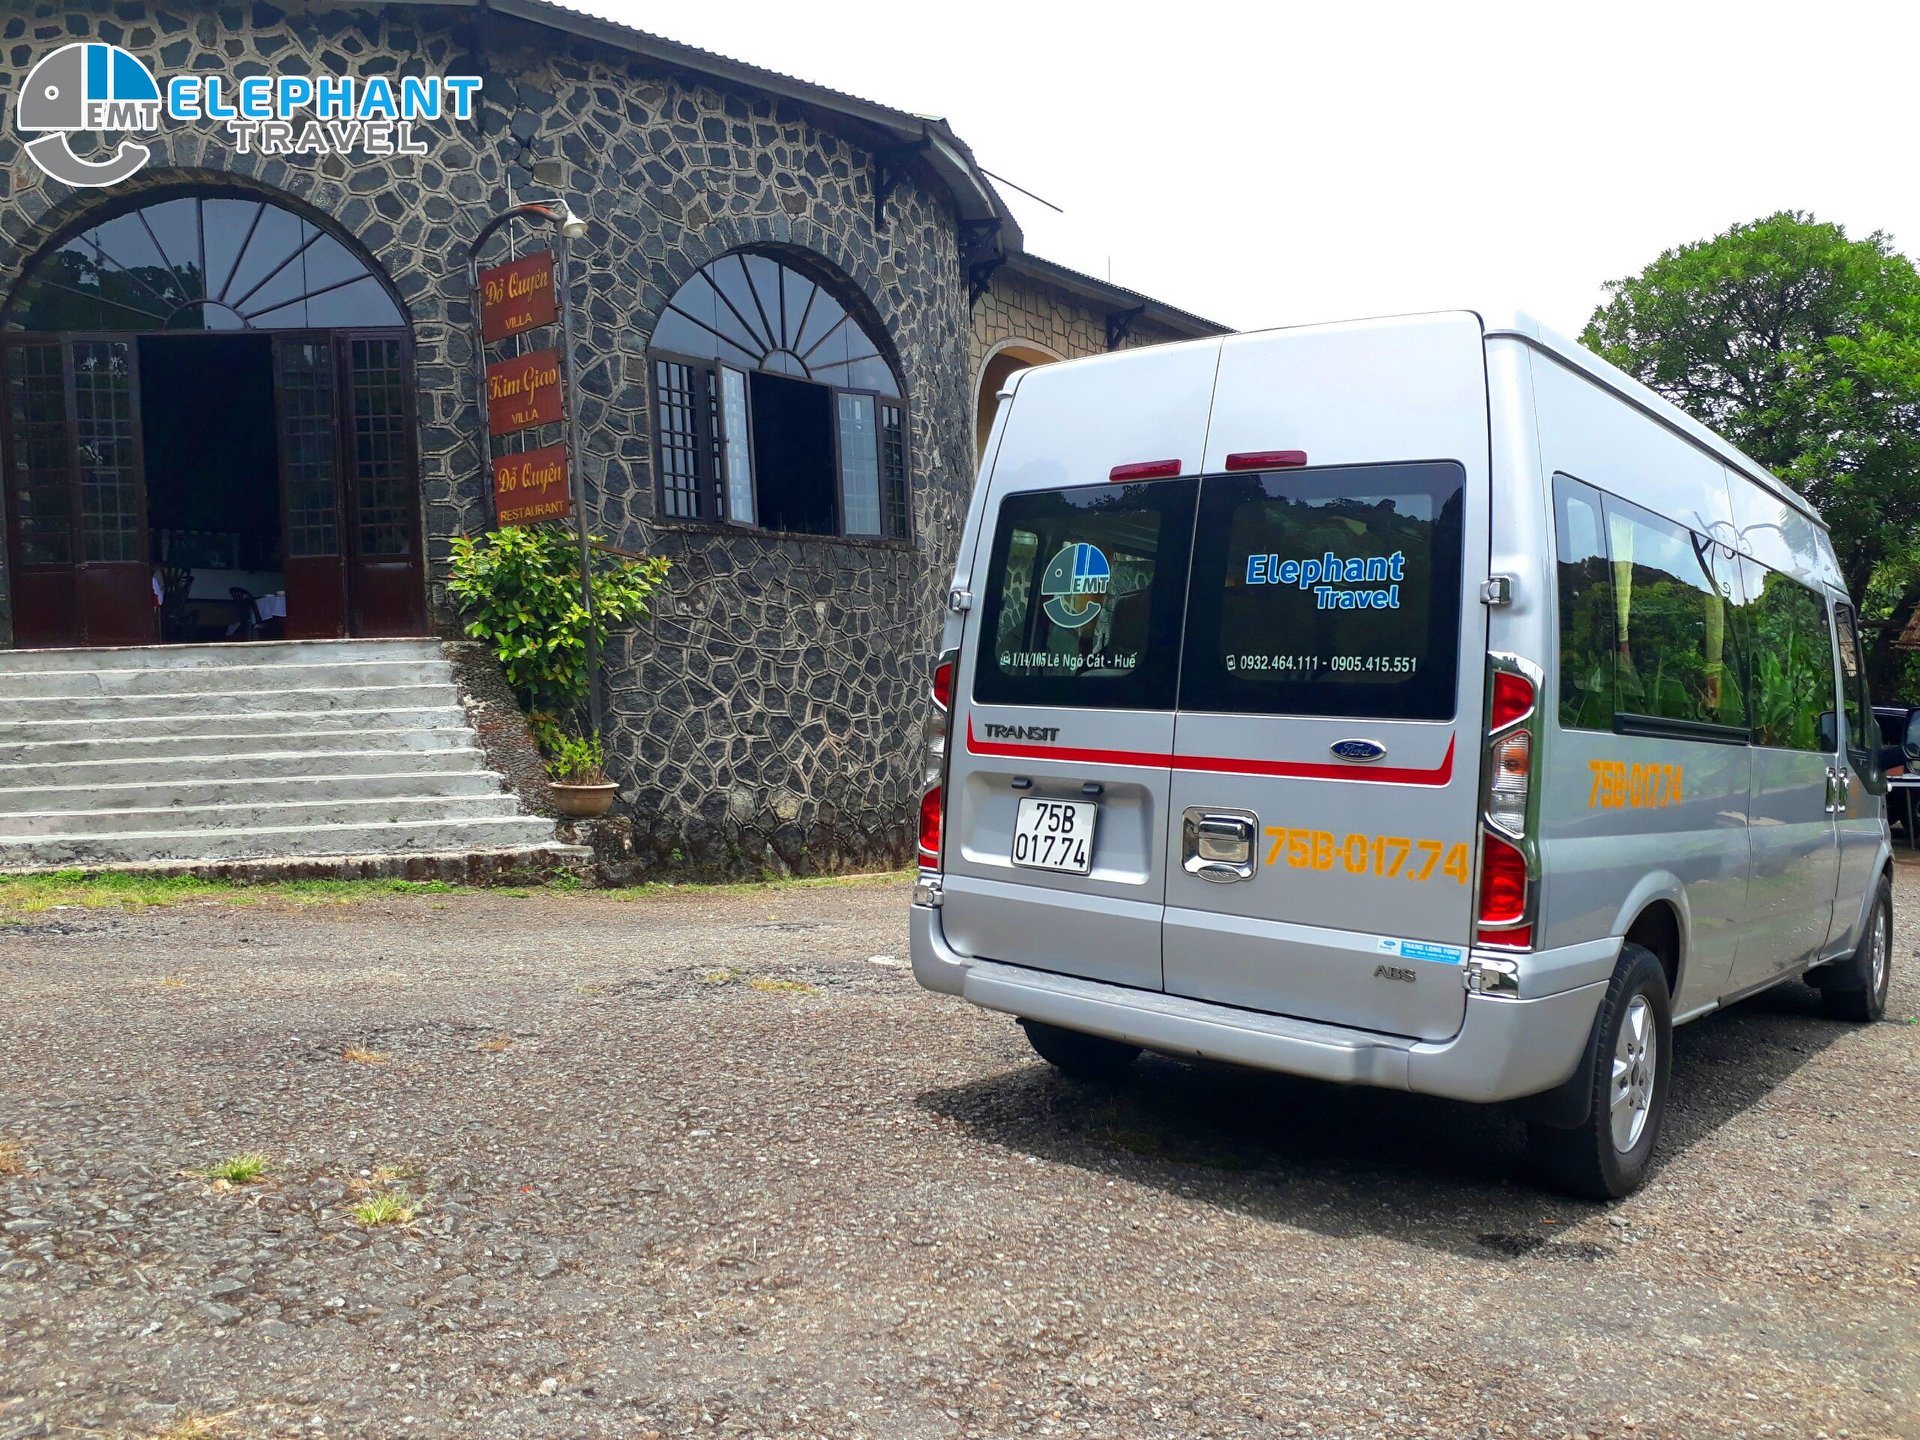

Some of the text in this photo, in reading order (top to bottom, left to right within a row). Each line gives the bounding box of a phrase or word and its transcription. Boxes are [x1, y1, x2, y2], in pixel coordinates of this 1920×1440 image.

[505, 312, 532, 330] VILLA
[489, 366, 557, 406] Kim Giao
[511, 408, 539, 425] VILLA
[500, 500, 565, 522] RESTAURANT
[1246, 550, 1405, 589] Elephant
[1073, 577, 1110, 593] EMT
[1314, 585, 1400, 609] Travel
[1047, 653, 1060, 667] Lê
[1062, 653, 1084, 671] Ngô
[1086, 653, 1105, 668] Cát
[1114, 651, 1138, 668] Huế
[1240, 655, 1318, 671] 0932.464.111
[1331, 656, 1417, 673] 0905.415.551
[984, 723, 1060, 742] TRANSIT
[1034, 803, 1076, 834] 75B
[1015, 833, 1086, 869] 017.74
[1264, 825, 1470, 885] 75B-017.74
[1373, 964, 1416, 982] ABS
